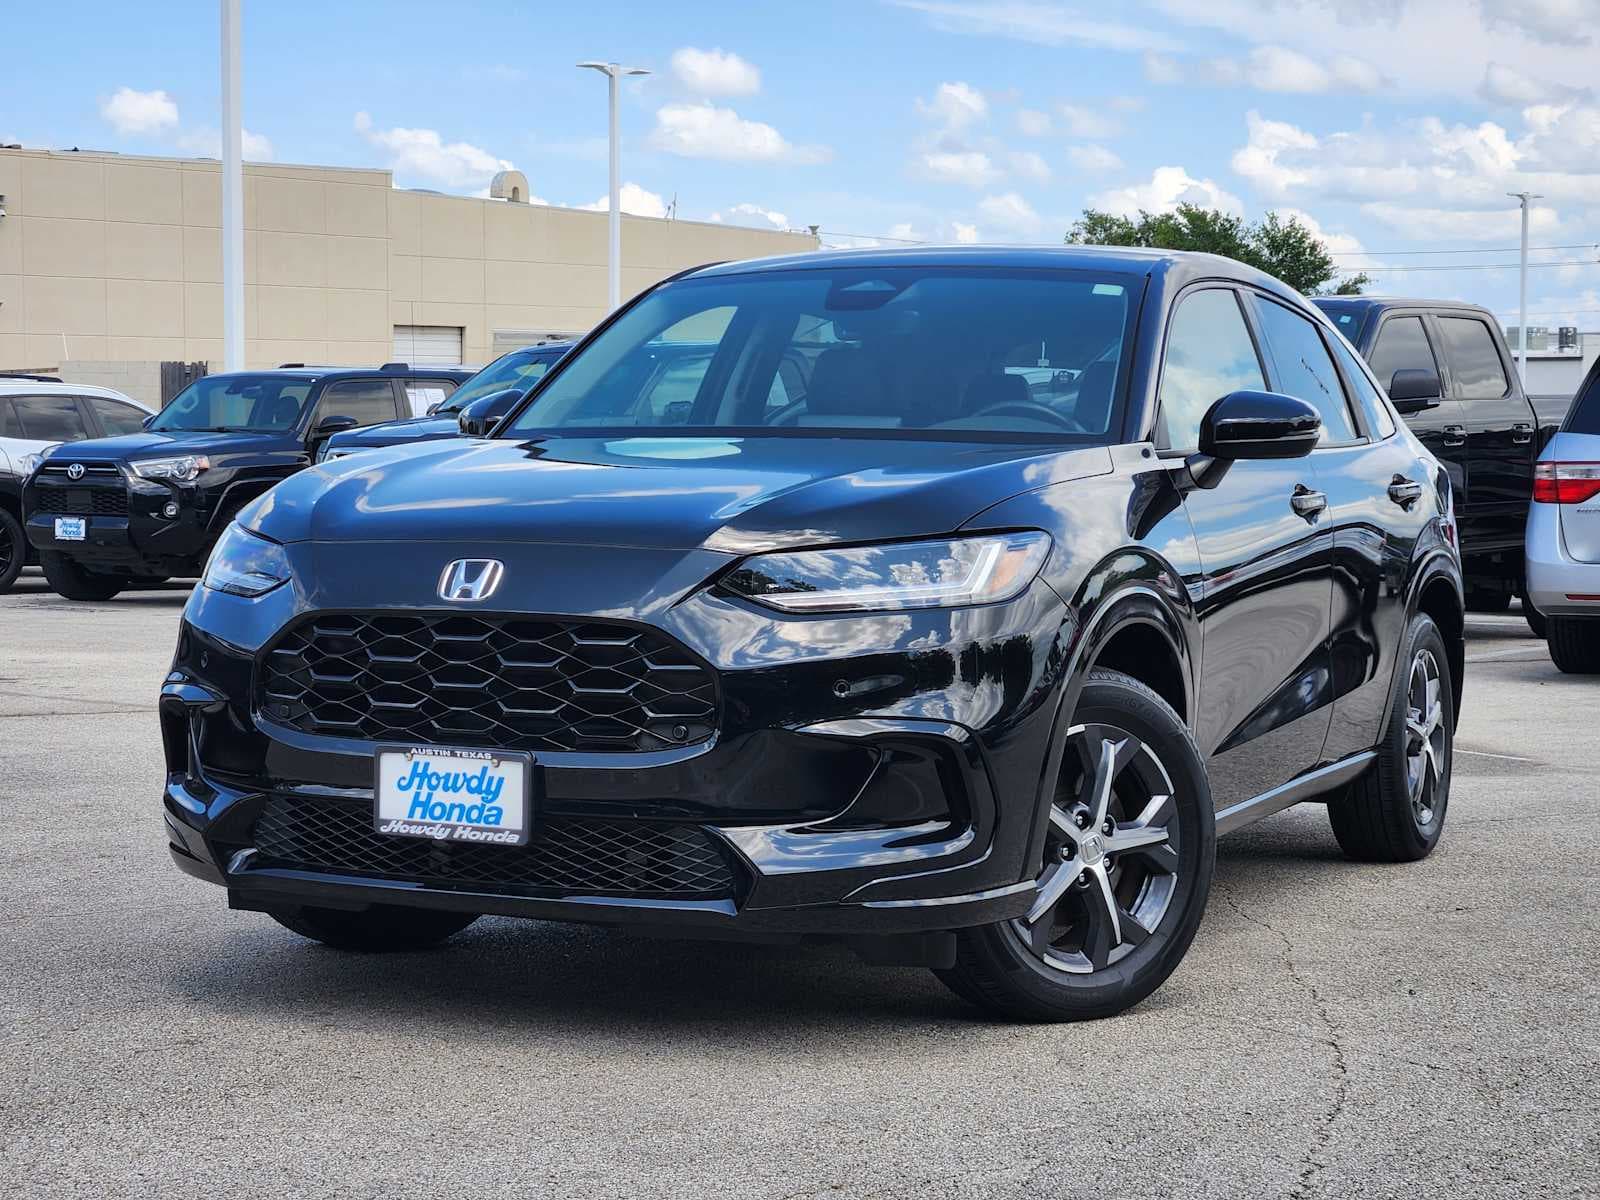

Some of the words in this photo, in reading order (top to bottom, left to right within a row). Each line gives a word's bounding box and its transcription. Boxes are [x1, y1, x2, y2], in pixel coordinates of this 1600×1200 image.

[410, 747, 451, 757] AUSTIN
[454, 751, 493, 760] TEXAS
[397, 760, 505, 803] Howdy
[407, 791, 504, 826] Honda
[380, 820, 451, 840] Howdy
[452, 825, 520, 844] Honda
